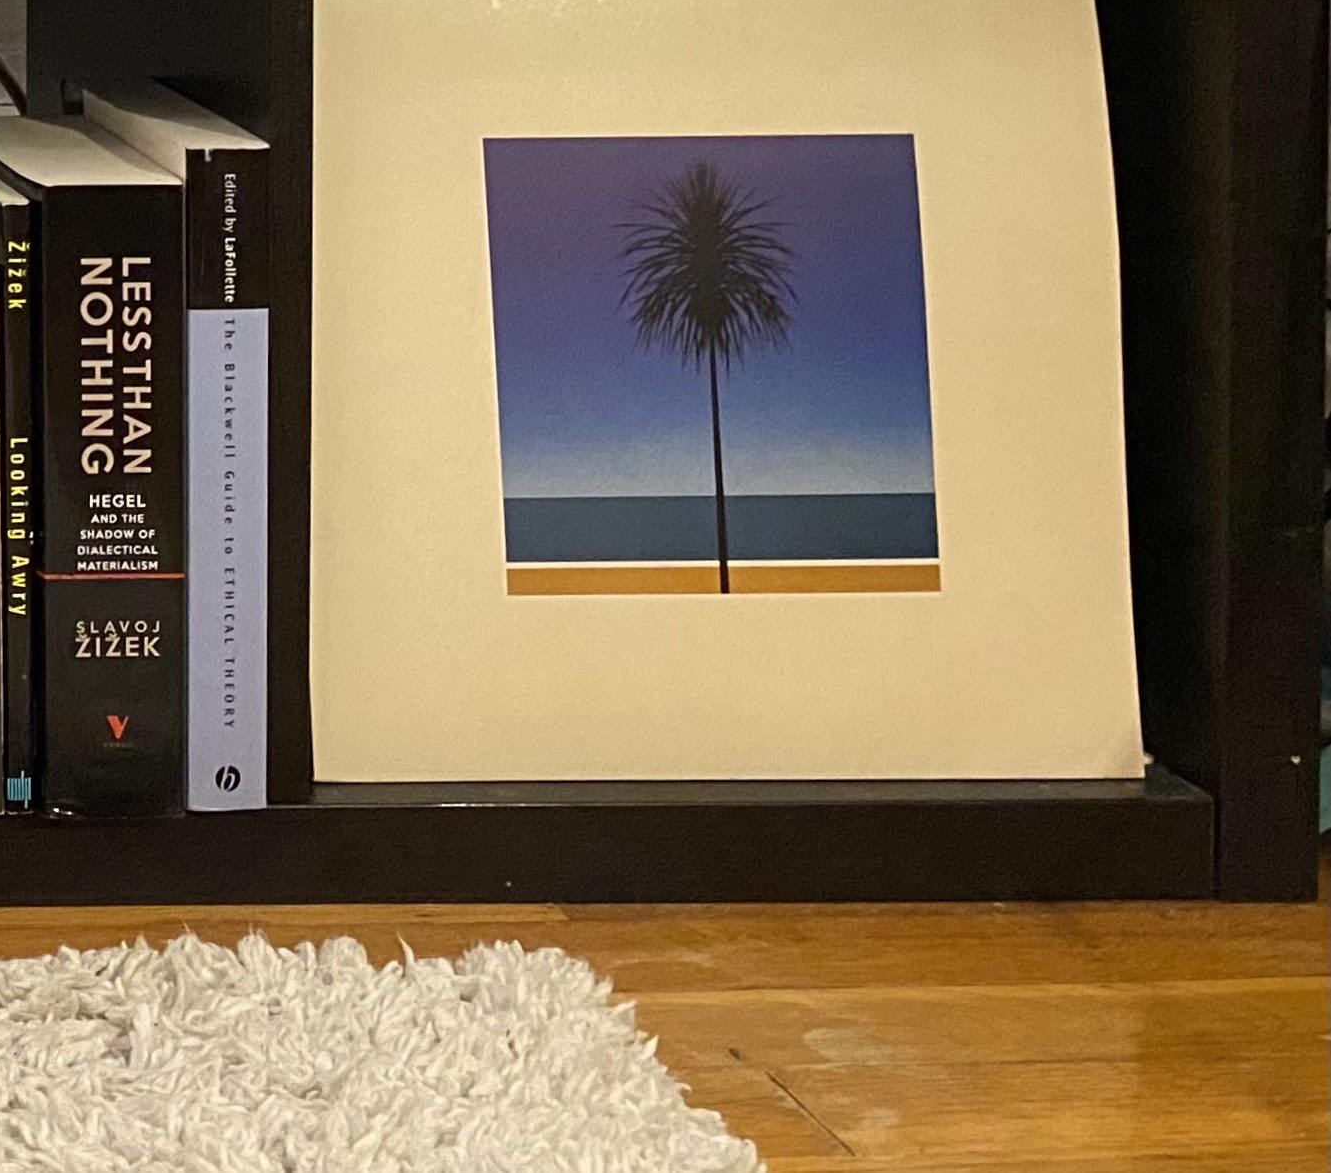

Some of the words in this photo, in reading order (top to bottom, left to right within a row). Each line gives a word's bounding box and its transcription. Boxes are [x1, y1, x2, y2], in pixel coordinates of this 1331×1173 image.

[225, 174, 236, 213] Edited
[225, 217, 236, 233] by
[225, 238, 236, 303] LaFollette
[121, 257, 152, 352] LESS
[80, 257, 114, 475] NOTHING
[122, 360, 152, 474] THAN
[89, 494, 146, 508] HEGEL
[75, 633, 161, 657] ŽIŽEK
[76, 621, 161, 633] SLAVOJ
